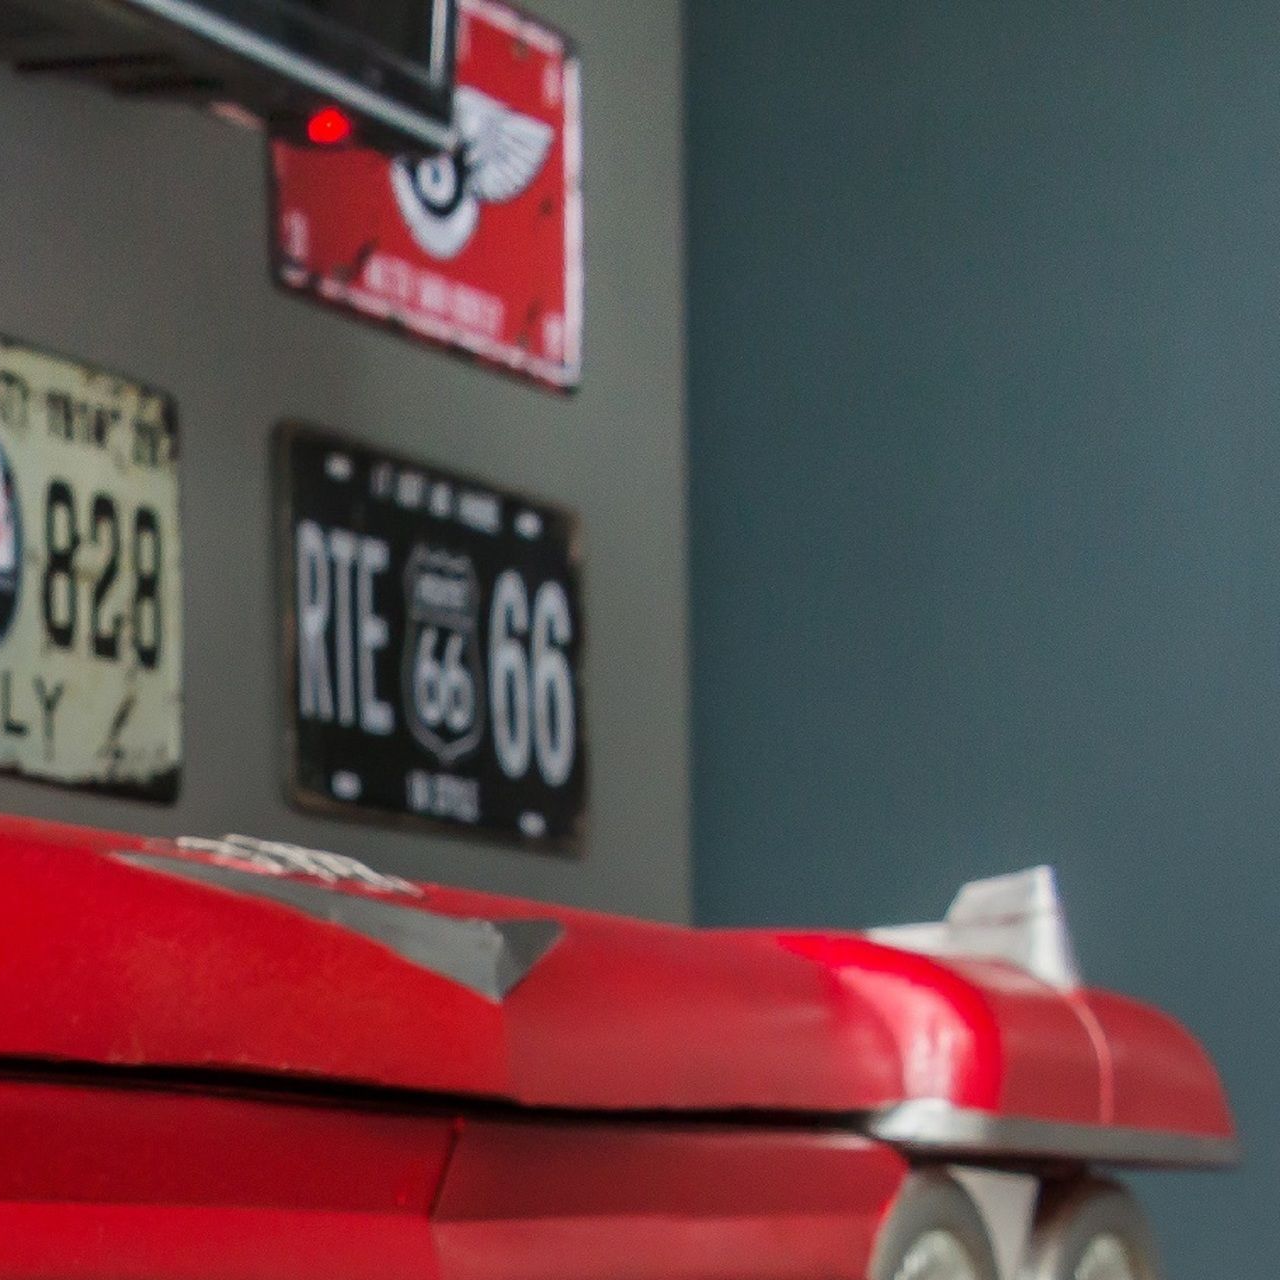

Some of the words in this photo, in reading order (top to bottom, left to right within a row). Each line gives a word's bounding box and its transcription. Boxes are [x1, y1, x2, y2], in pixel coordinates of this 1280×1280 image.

[44, 479, 162, 672] 828
[296, 518, 395, 736] RTE
[488, 569, 576, 788] 66
[413, 627, 476, 735] 66
